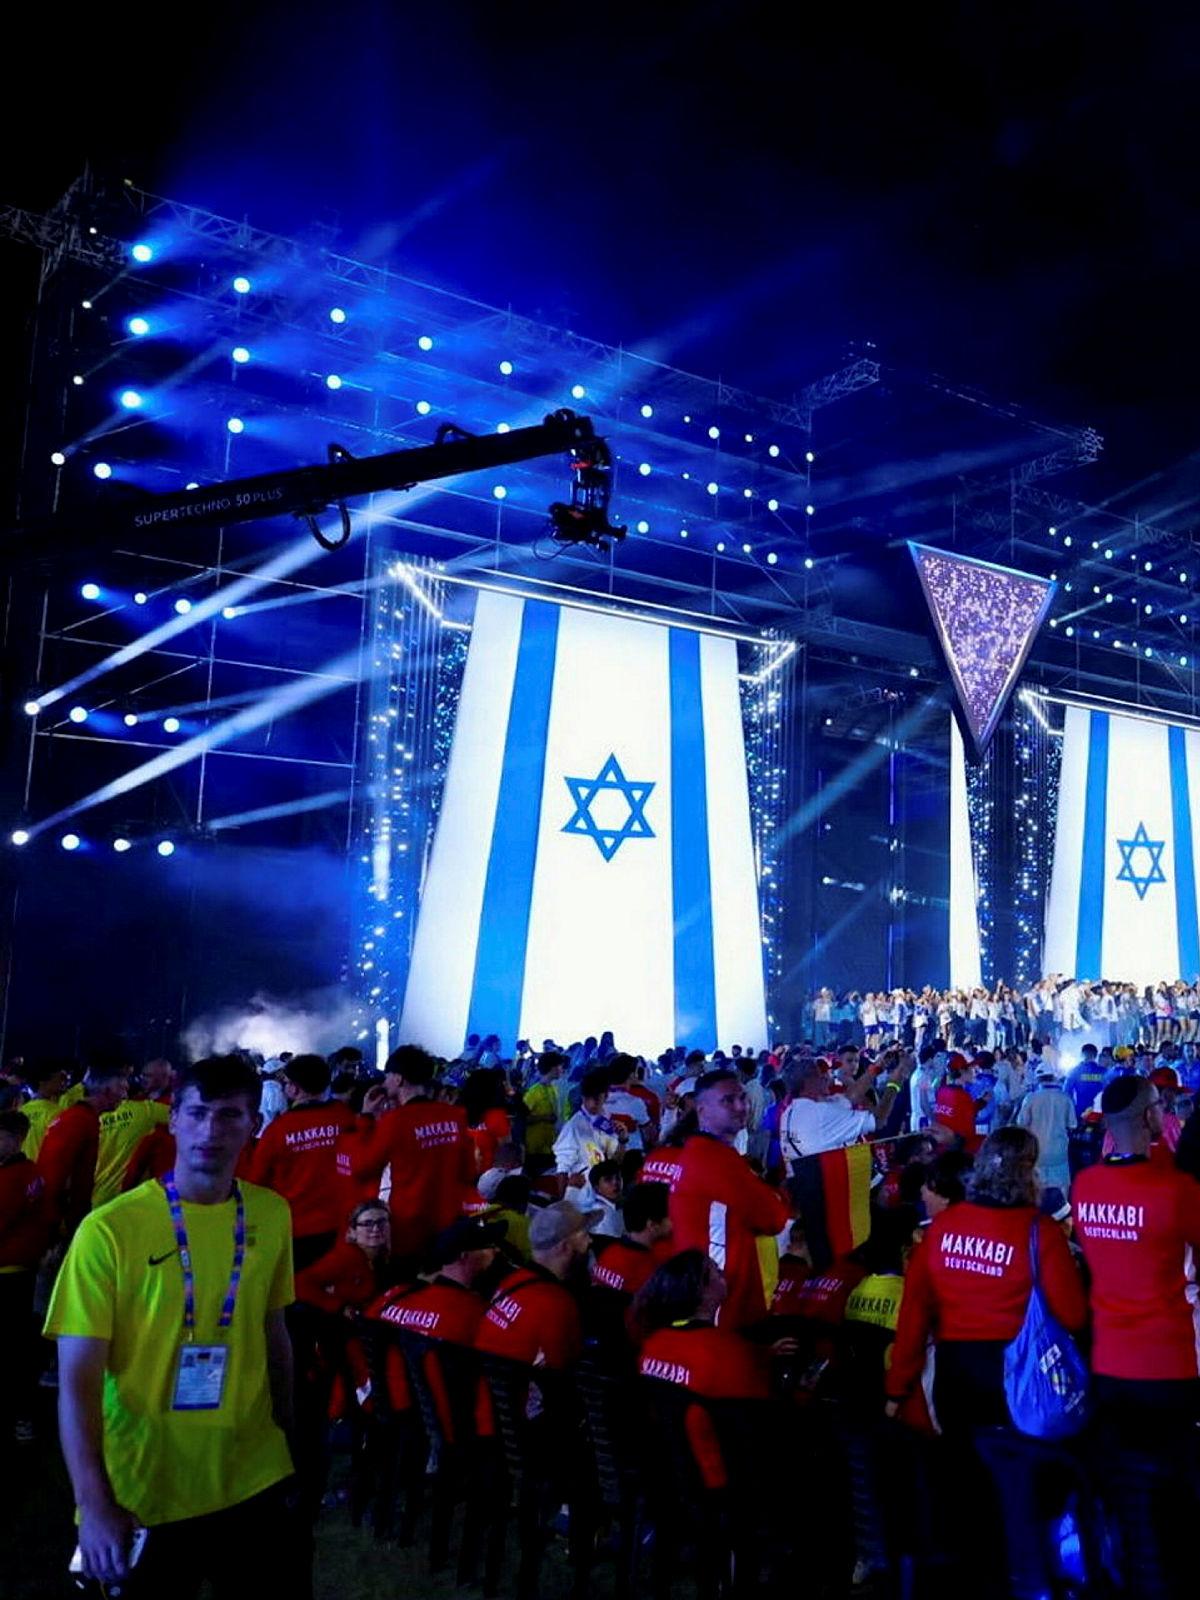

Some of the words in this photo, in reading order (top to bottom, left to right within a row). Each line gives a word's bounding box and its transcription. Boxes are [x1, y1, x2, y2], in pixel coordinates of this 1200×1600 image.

[134, 498, 231, 527] SUPERTECHNO
[236, 493, 251, 507] 50
[251, 487, 284, 502] PLUS
[285, 1124, 340, 1146] MAKKABI
[414, 1121, 459, 1140] MAKKABI
[1078, 1202, 1144, 1228] MAKKABI
[941, 1232, 1015, 1267] MAKKABI
[944, 1256, 1004, 1278] DEUTSCHLAND
[640, 1357, 690, 1386] MAKKABI
